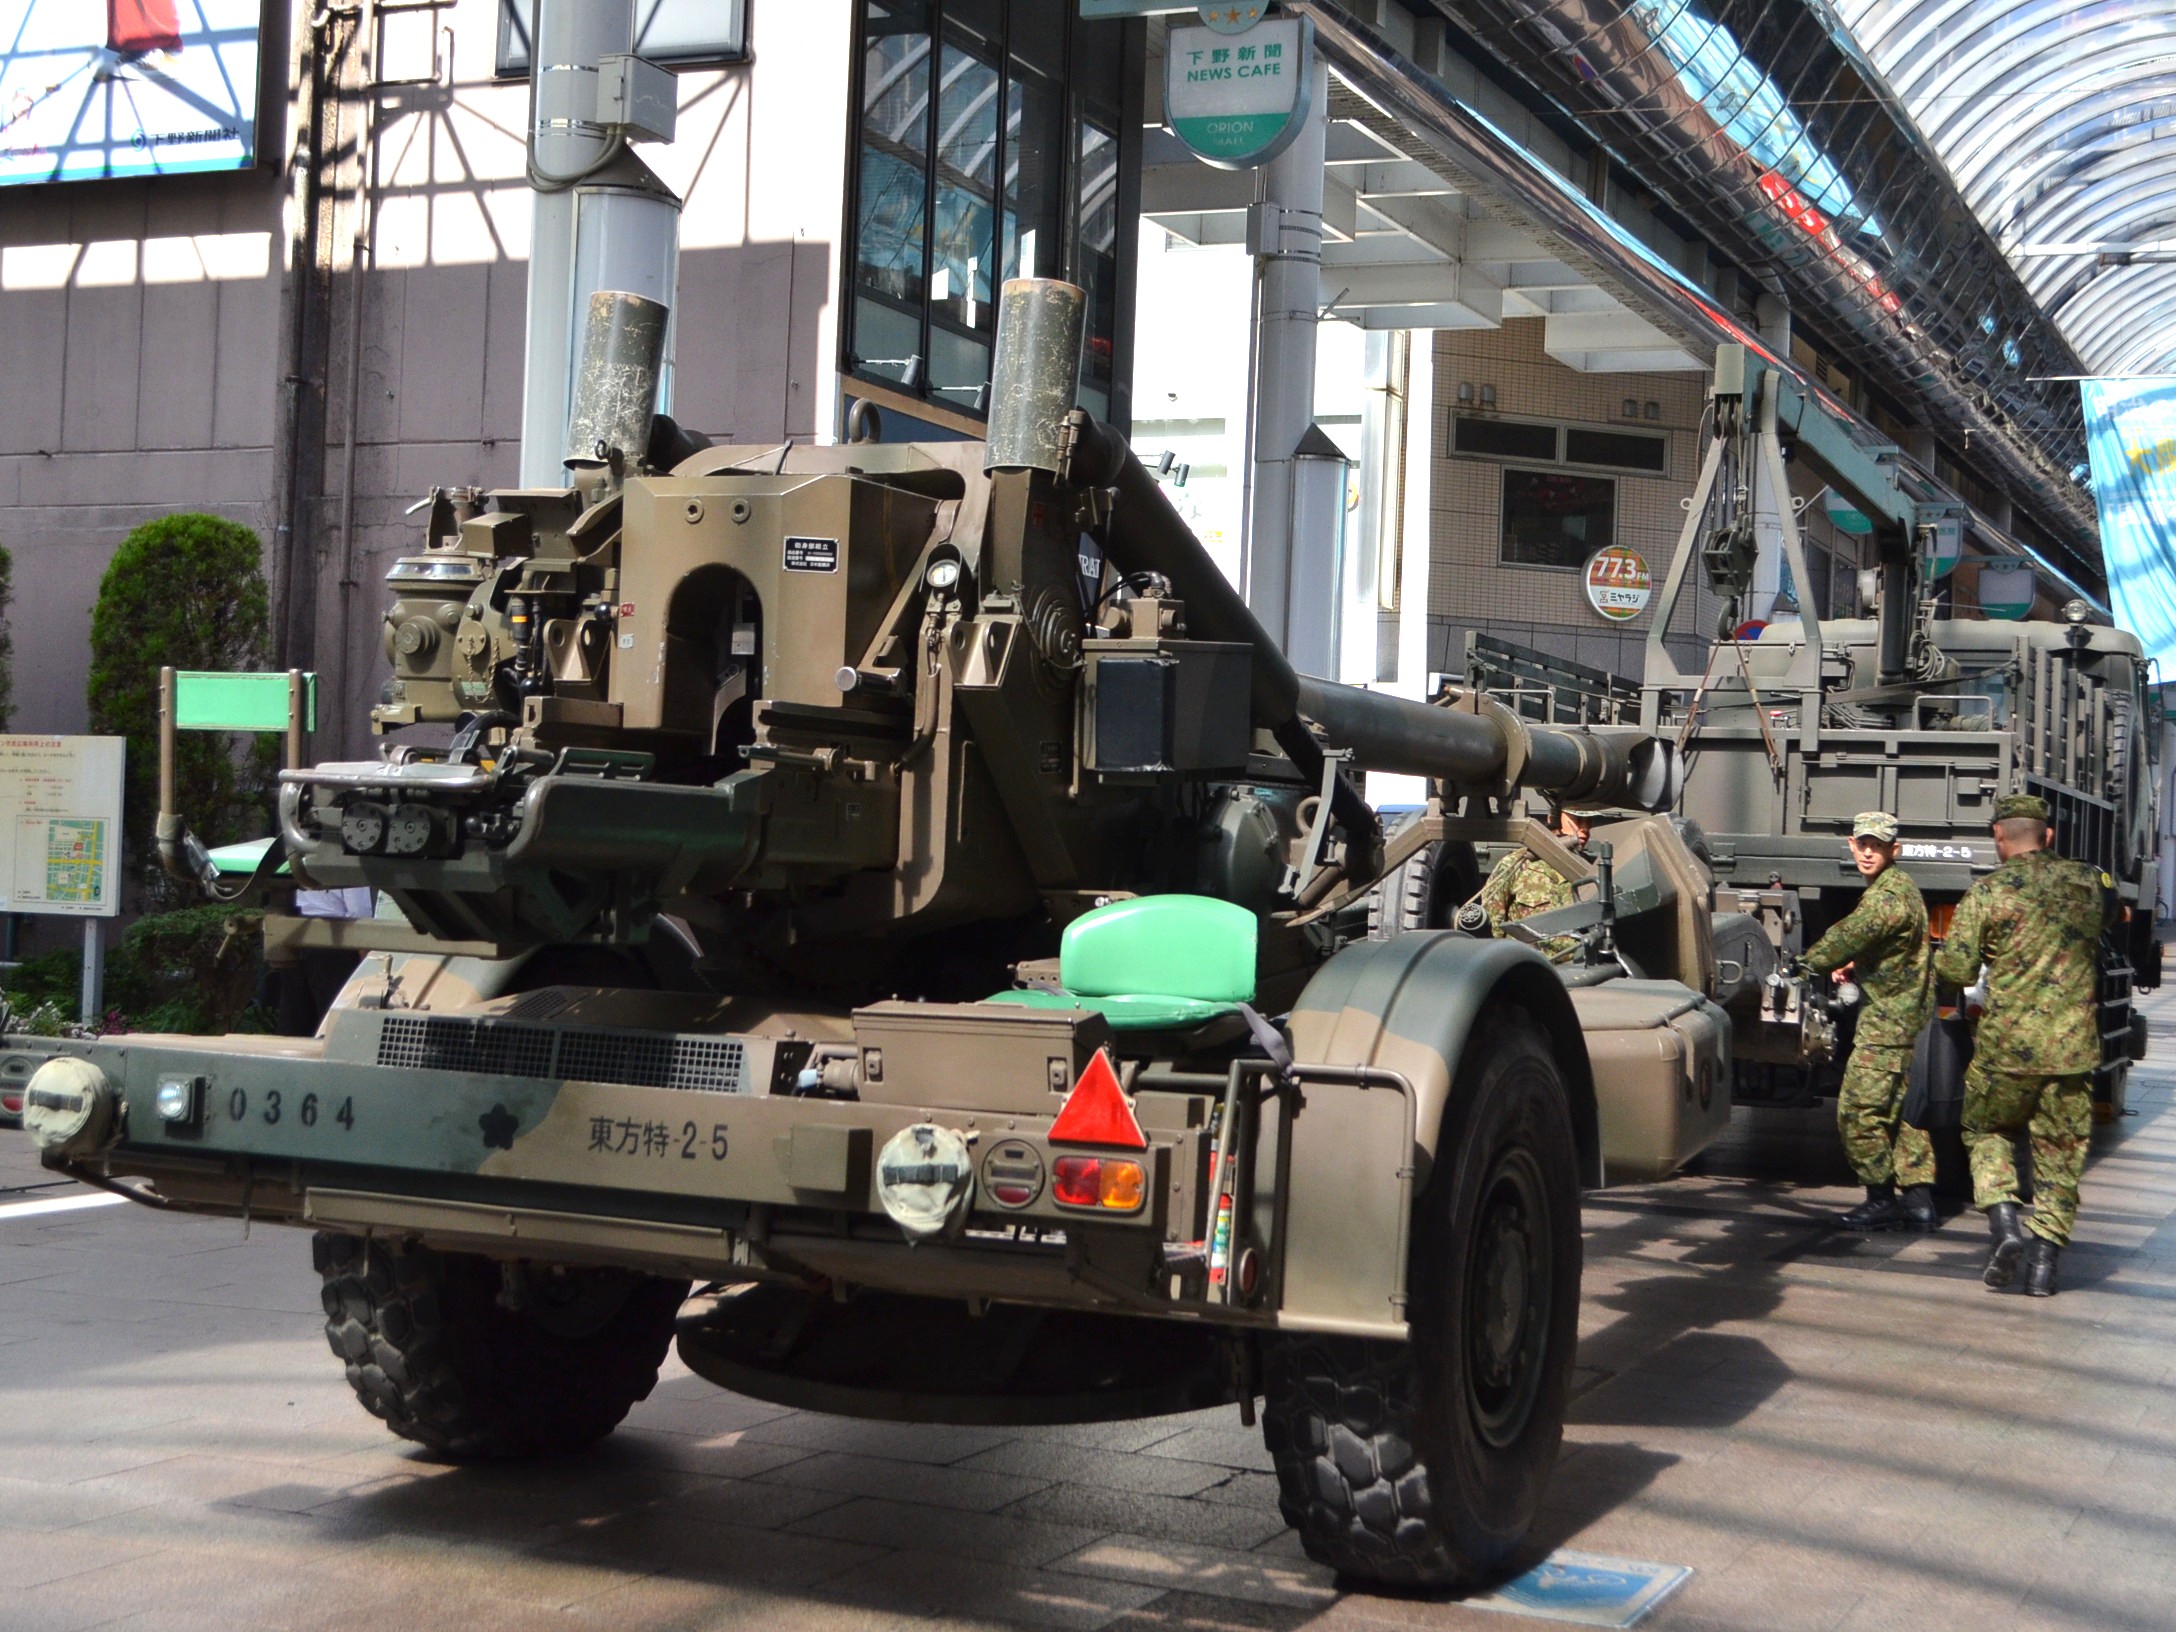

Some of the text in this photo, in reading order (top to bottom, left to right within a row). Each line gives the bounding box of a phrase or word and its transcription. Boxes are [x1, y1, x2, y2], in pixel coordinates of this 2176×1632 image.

[1186, 43, 1283, 66] 下野新聞
[1187, 63, 1280, 82] NEWS CAFE
[1206, 120, 1254, 135] ORION
[1595, 556, 1649, 581] 77.3 FM
[1609, 592, 1641, 604] ミヤラジ
[229, 1086, 355, 1132] 0364
